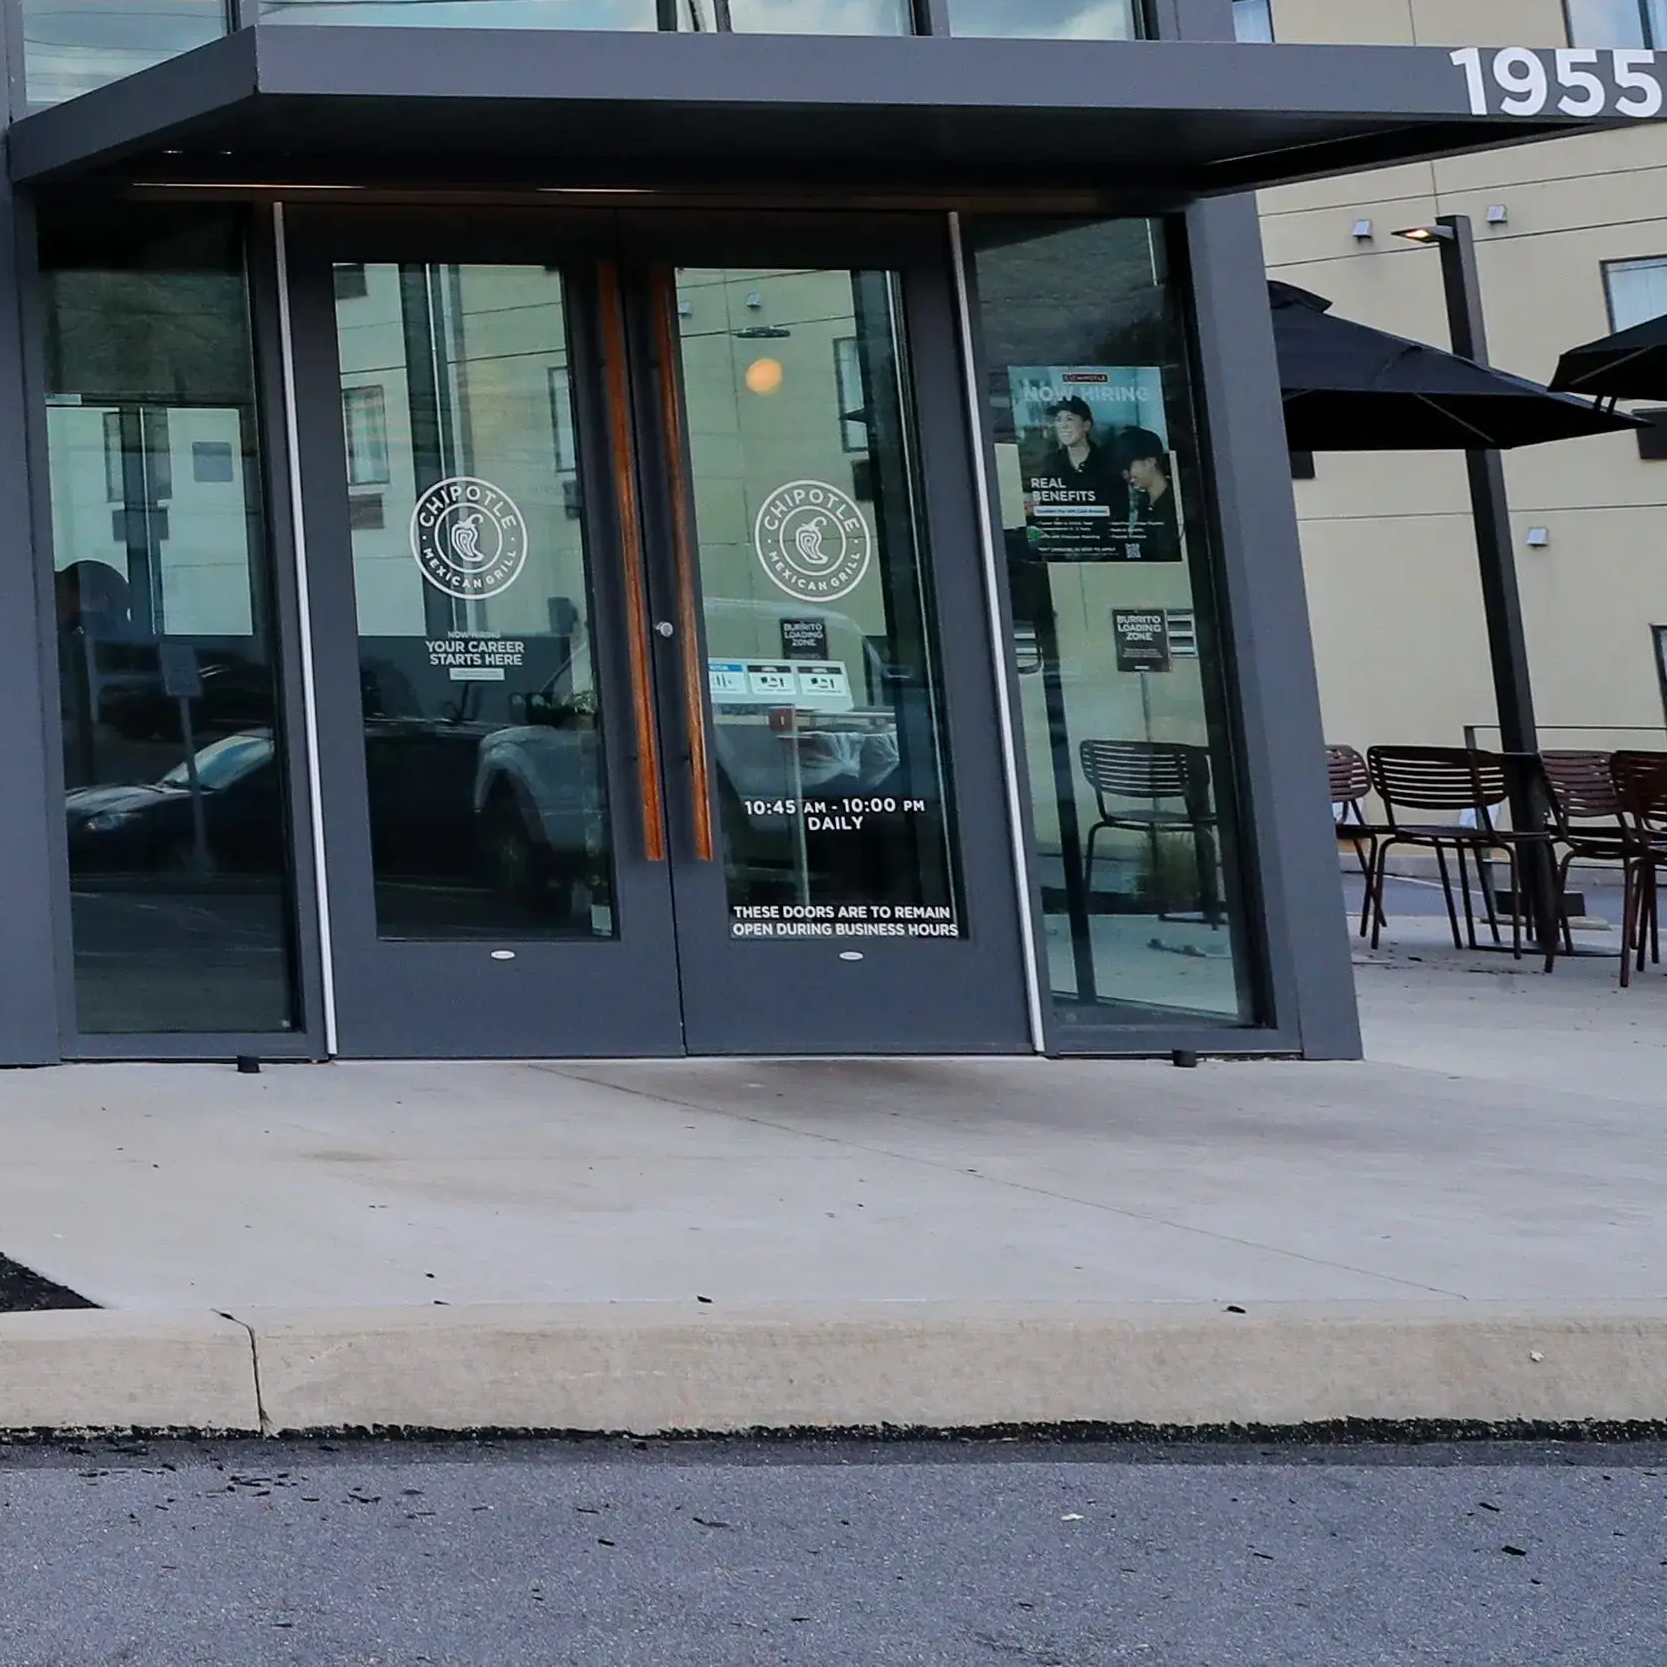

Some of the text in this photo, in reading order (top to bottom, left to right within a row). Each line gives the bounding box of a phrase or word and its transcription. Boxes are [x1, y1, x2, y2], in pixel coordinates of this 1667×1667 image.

[1449, 46, 1663, 118] 1955
[1081, 387, 1149, 402] HIRING
[1031, 477, 1067, 489] REAL
[1032, 490, 1096, 502] BENEFITS
[419, 486, 517, 529] CHIPOTLE
[764, 489, 860, 532] CHIPOTLE
[423, 548, 516, 588] MEXICAN GRILL
[769, 551, 861, 590] MEXICAN GRILL
[1116, 615, 1161, 624] BURRITO
[783, 623, 823, 632] BURRITO
[1118, 624, 1162, 633] LOADING
[792, 639, 816, 647] ZONE
[1126, 632, 1153, 641] ZONE
[426, 641, 525, 653] YOUR CAREER
[430, 654, 523, 665] STARTS HERE
[745, 800, 796, 815] 10:45
[804, 801, 827, 813] AM
[842, 798, 896, 813] 10:00
[903, 800, 925, 811] PM
[808, 816, 864, 830] DAILY
[733, 906, 950, 919] THESE DOORS ARE TO REMAIN
[733, 923, 958, 937] OPEN DURING BUSINESS HOURS
